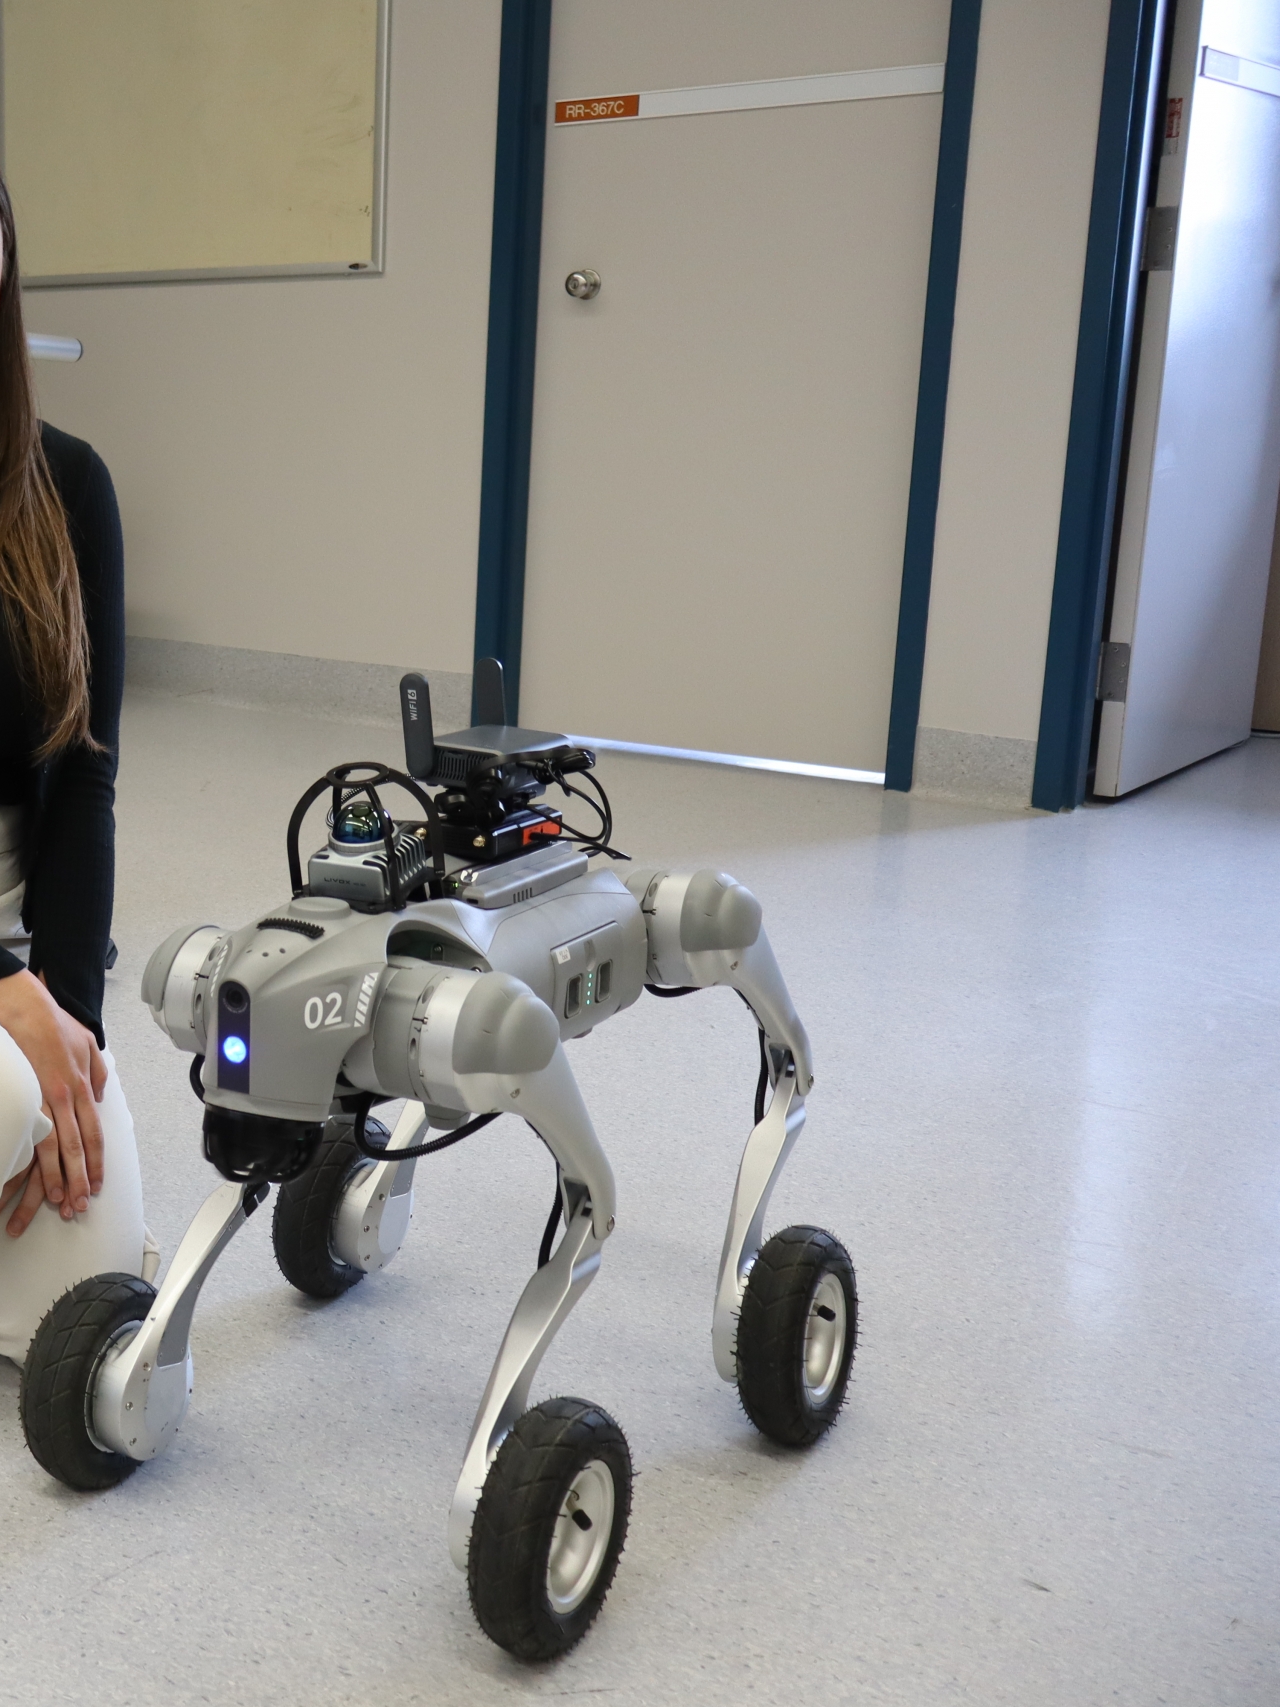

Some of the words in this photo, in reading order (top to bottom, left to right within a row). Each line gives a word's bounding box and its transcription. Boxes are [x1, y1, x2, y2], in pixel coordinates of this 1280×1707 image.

[566, 100, 625, 118] RR-367C
[408, 690, 417, 699] 6
[304, 991, 342, 1029] 02
